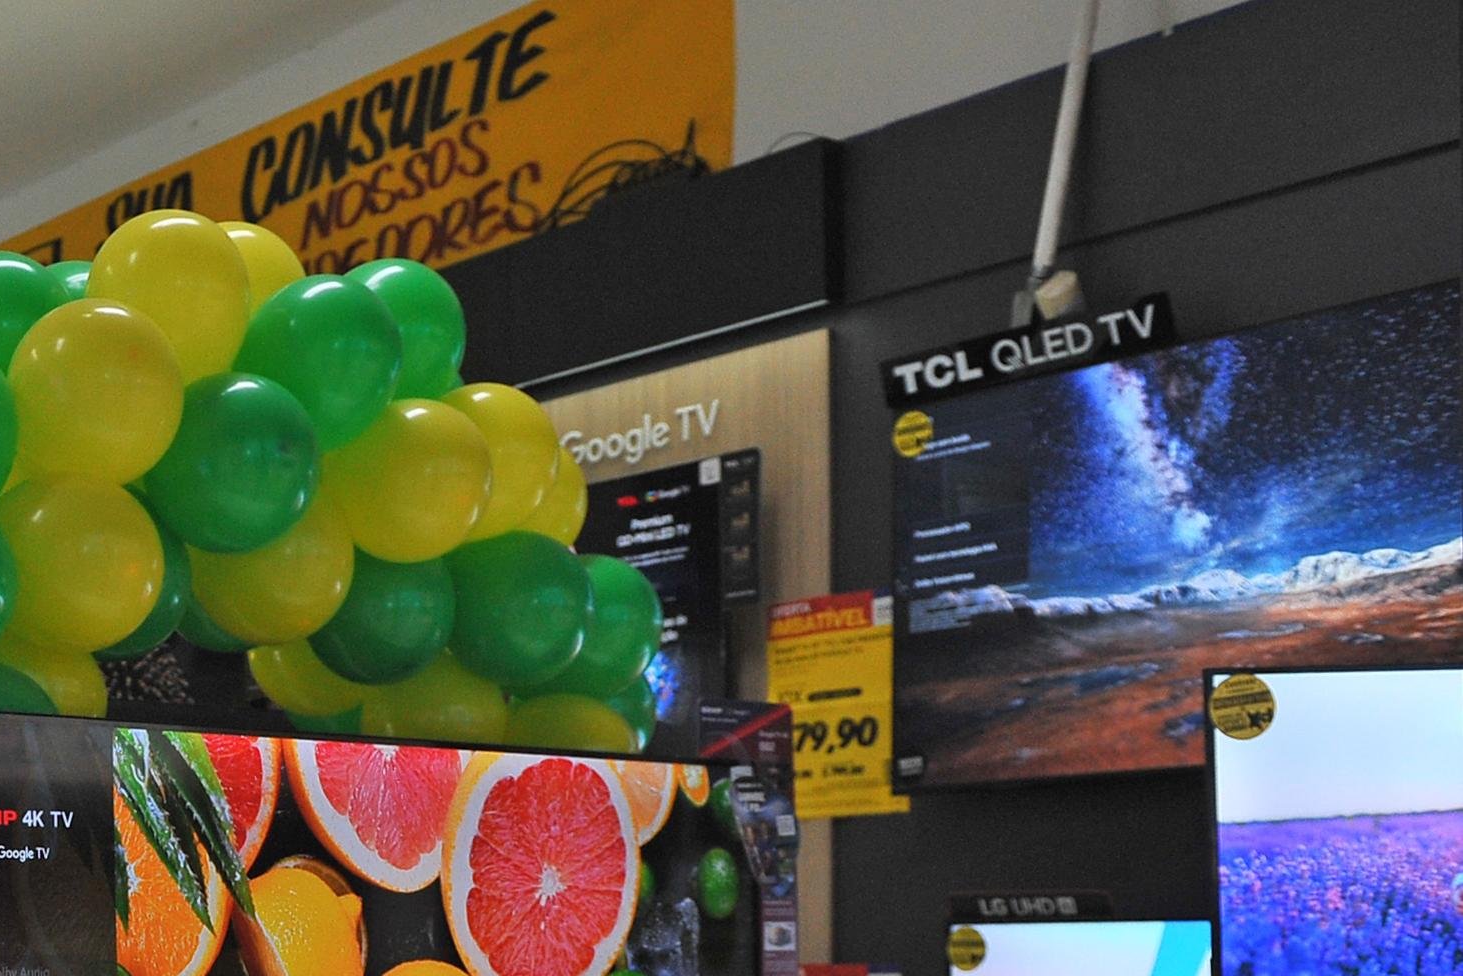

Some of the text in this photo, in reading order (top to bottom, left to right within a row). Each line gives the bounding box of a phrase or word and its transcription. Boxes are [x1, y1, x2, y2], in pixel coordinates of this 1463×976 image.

[242, 10, 557, 224] CONSULTE
[301, 119, 490, 250] NOSSOS
[893, 304, 1155, 394] TCL QLED TV
[560, 399, 720, 464] Google TV
[22, 809, 46, 828] 4K
[50, 811, 74, 829] TV
[36, 848, 50, 860] TV
[978, 896, 1056, 916] LG UHD
